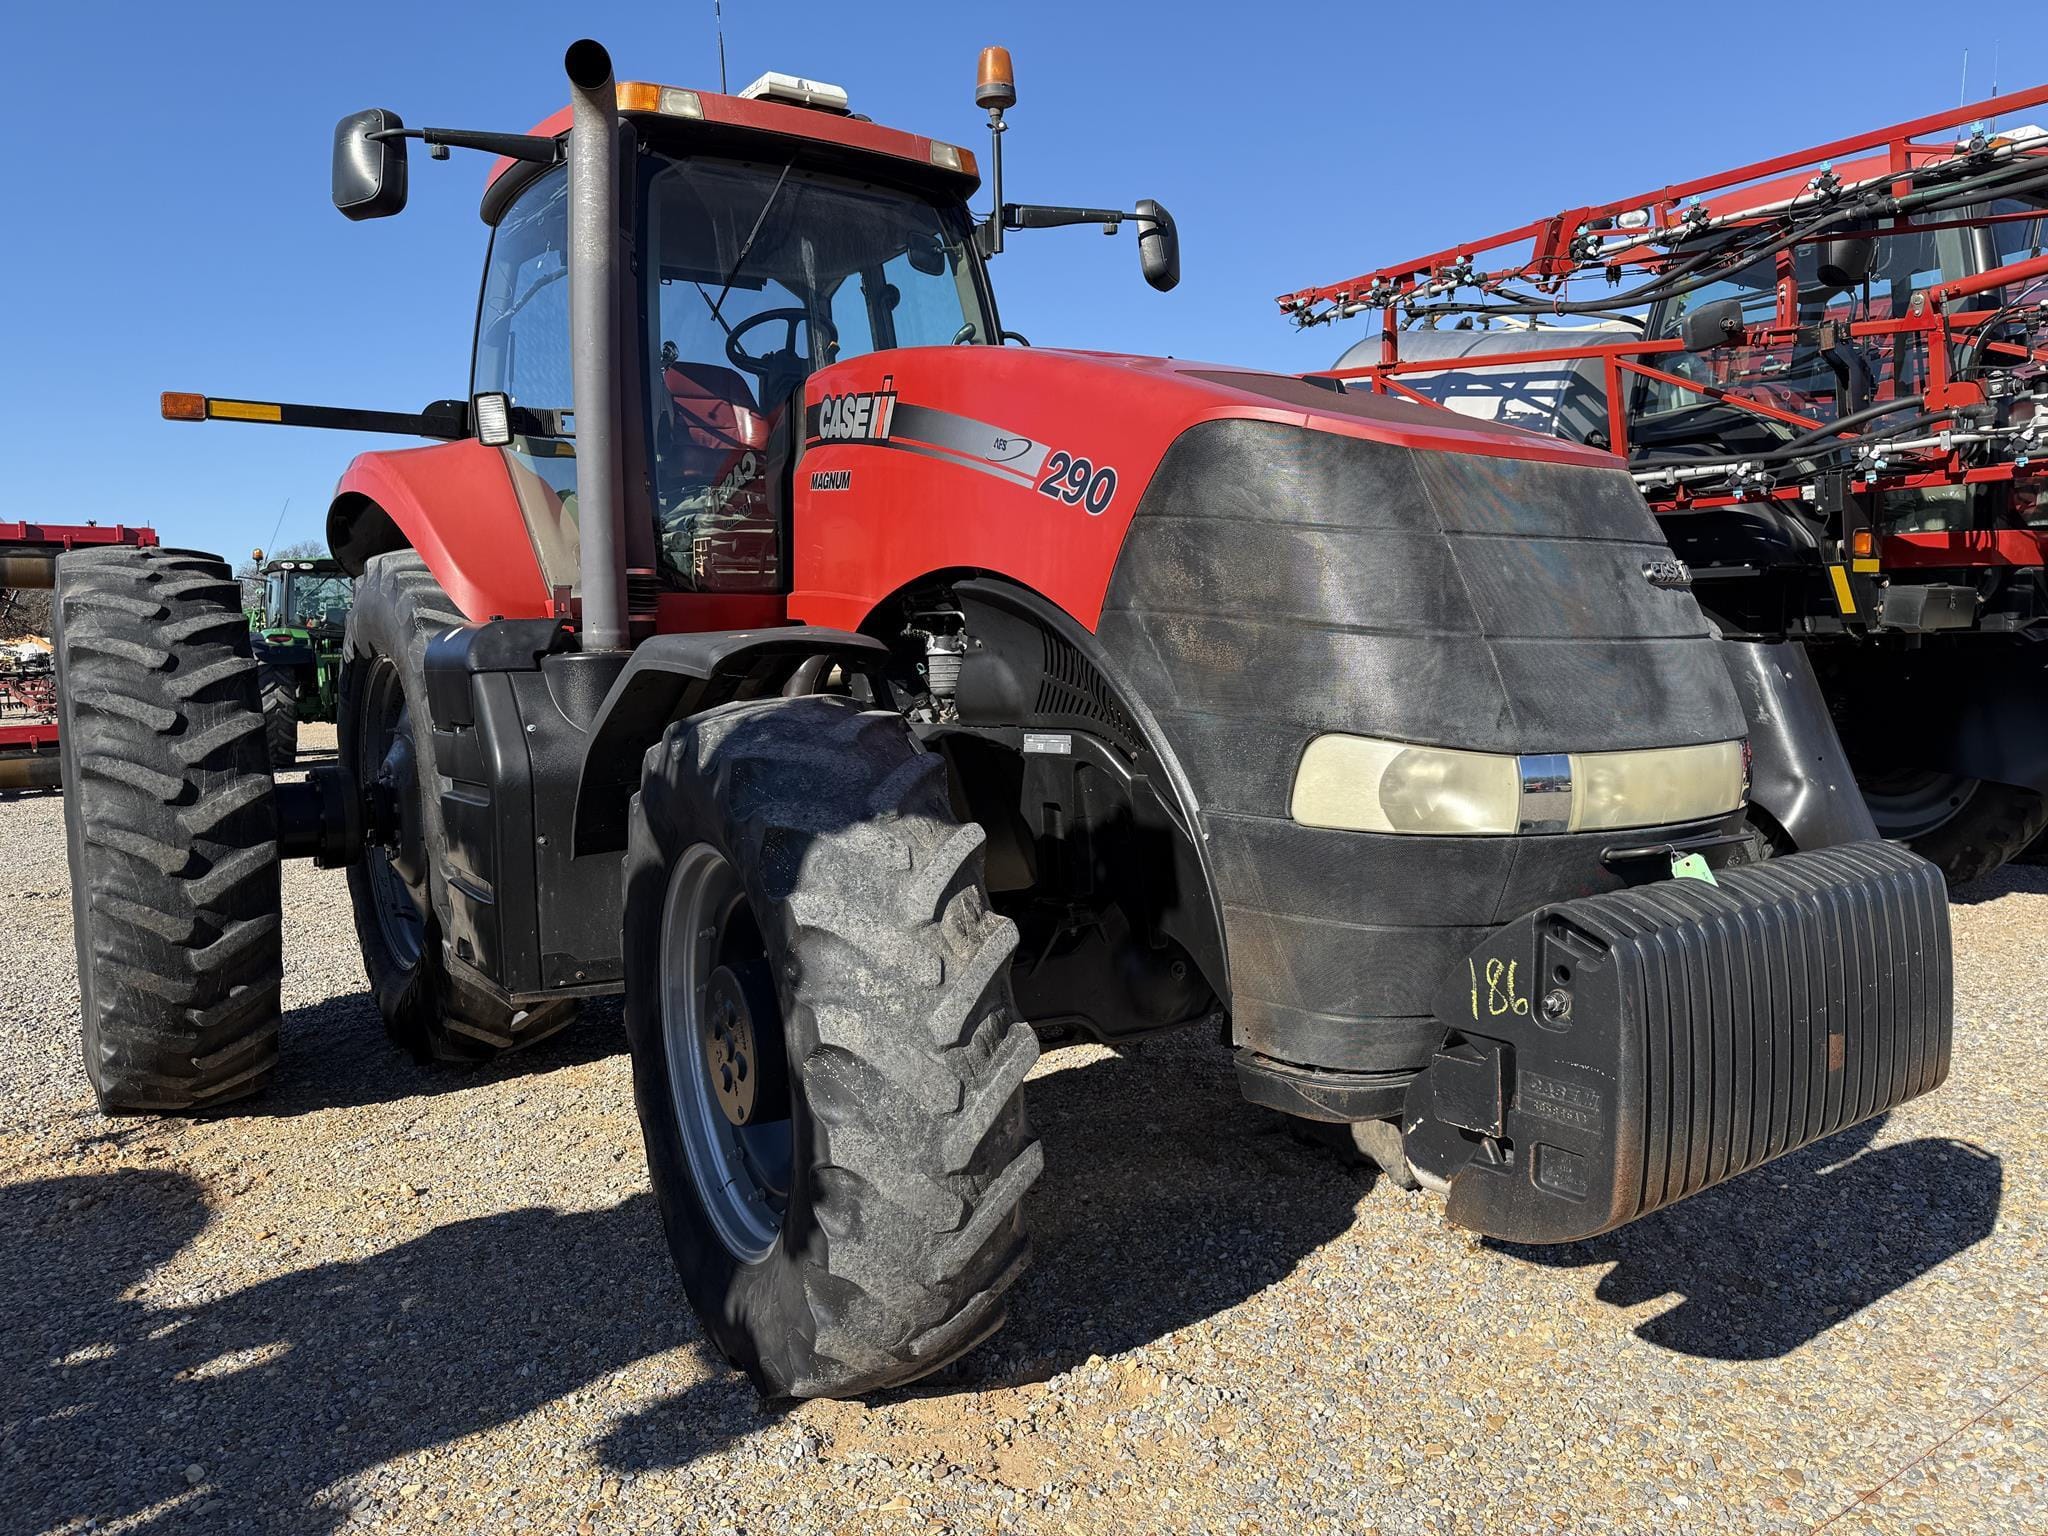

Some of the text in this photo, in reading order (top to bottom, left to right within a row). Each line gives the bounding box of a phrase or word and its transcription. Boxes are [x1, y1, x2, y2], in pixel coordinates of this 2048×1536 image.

[818, 394, 871, 440] CASE
[993, 437, 1008, 451] AFS
[810, 470, 852, 491] MAGNUM
[1037, 450, 1119, 516] 290
[1469, 958, 1528, 1020] 186
